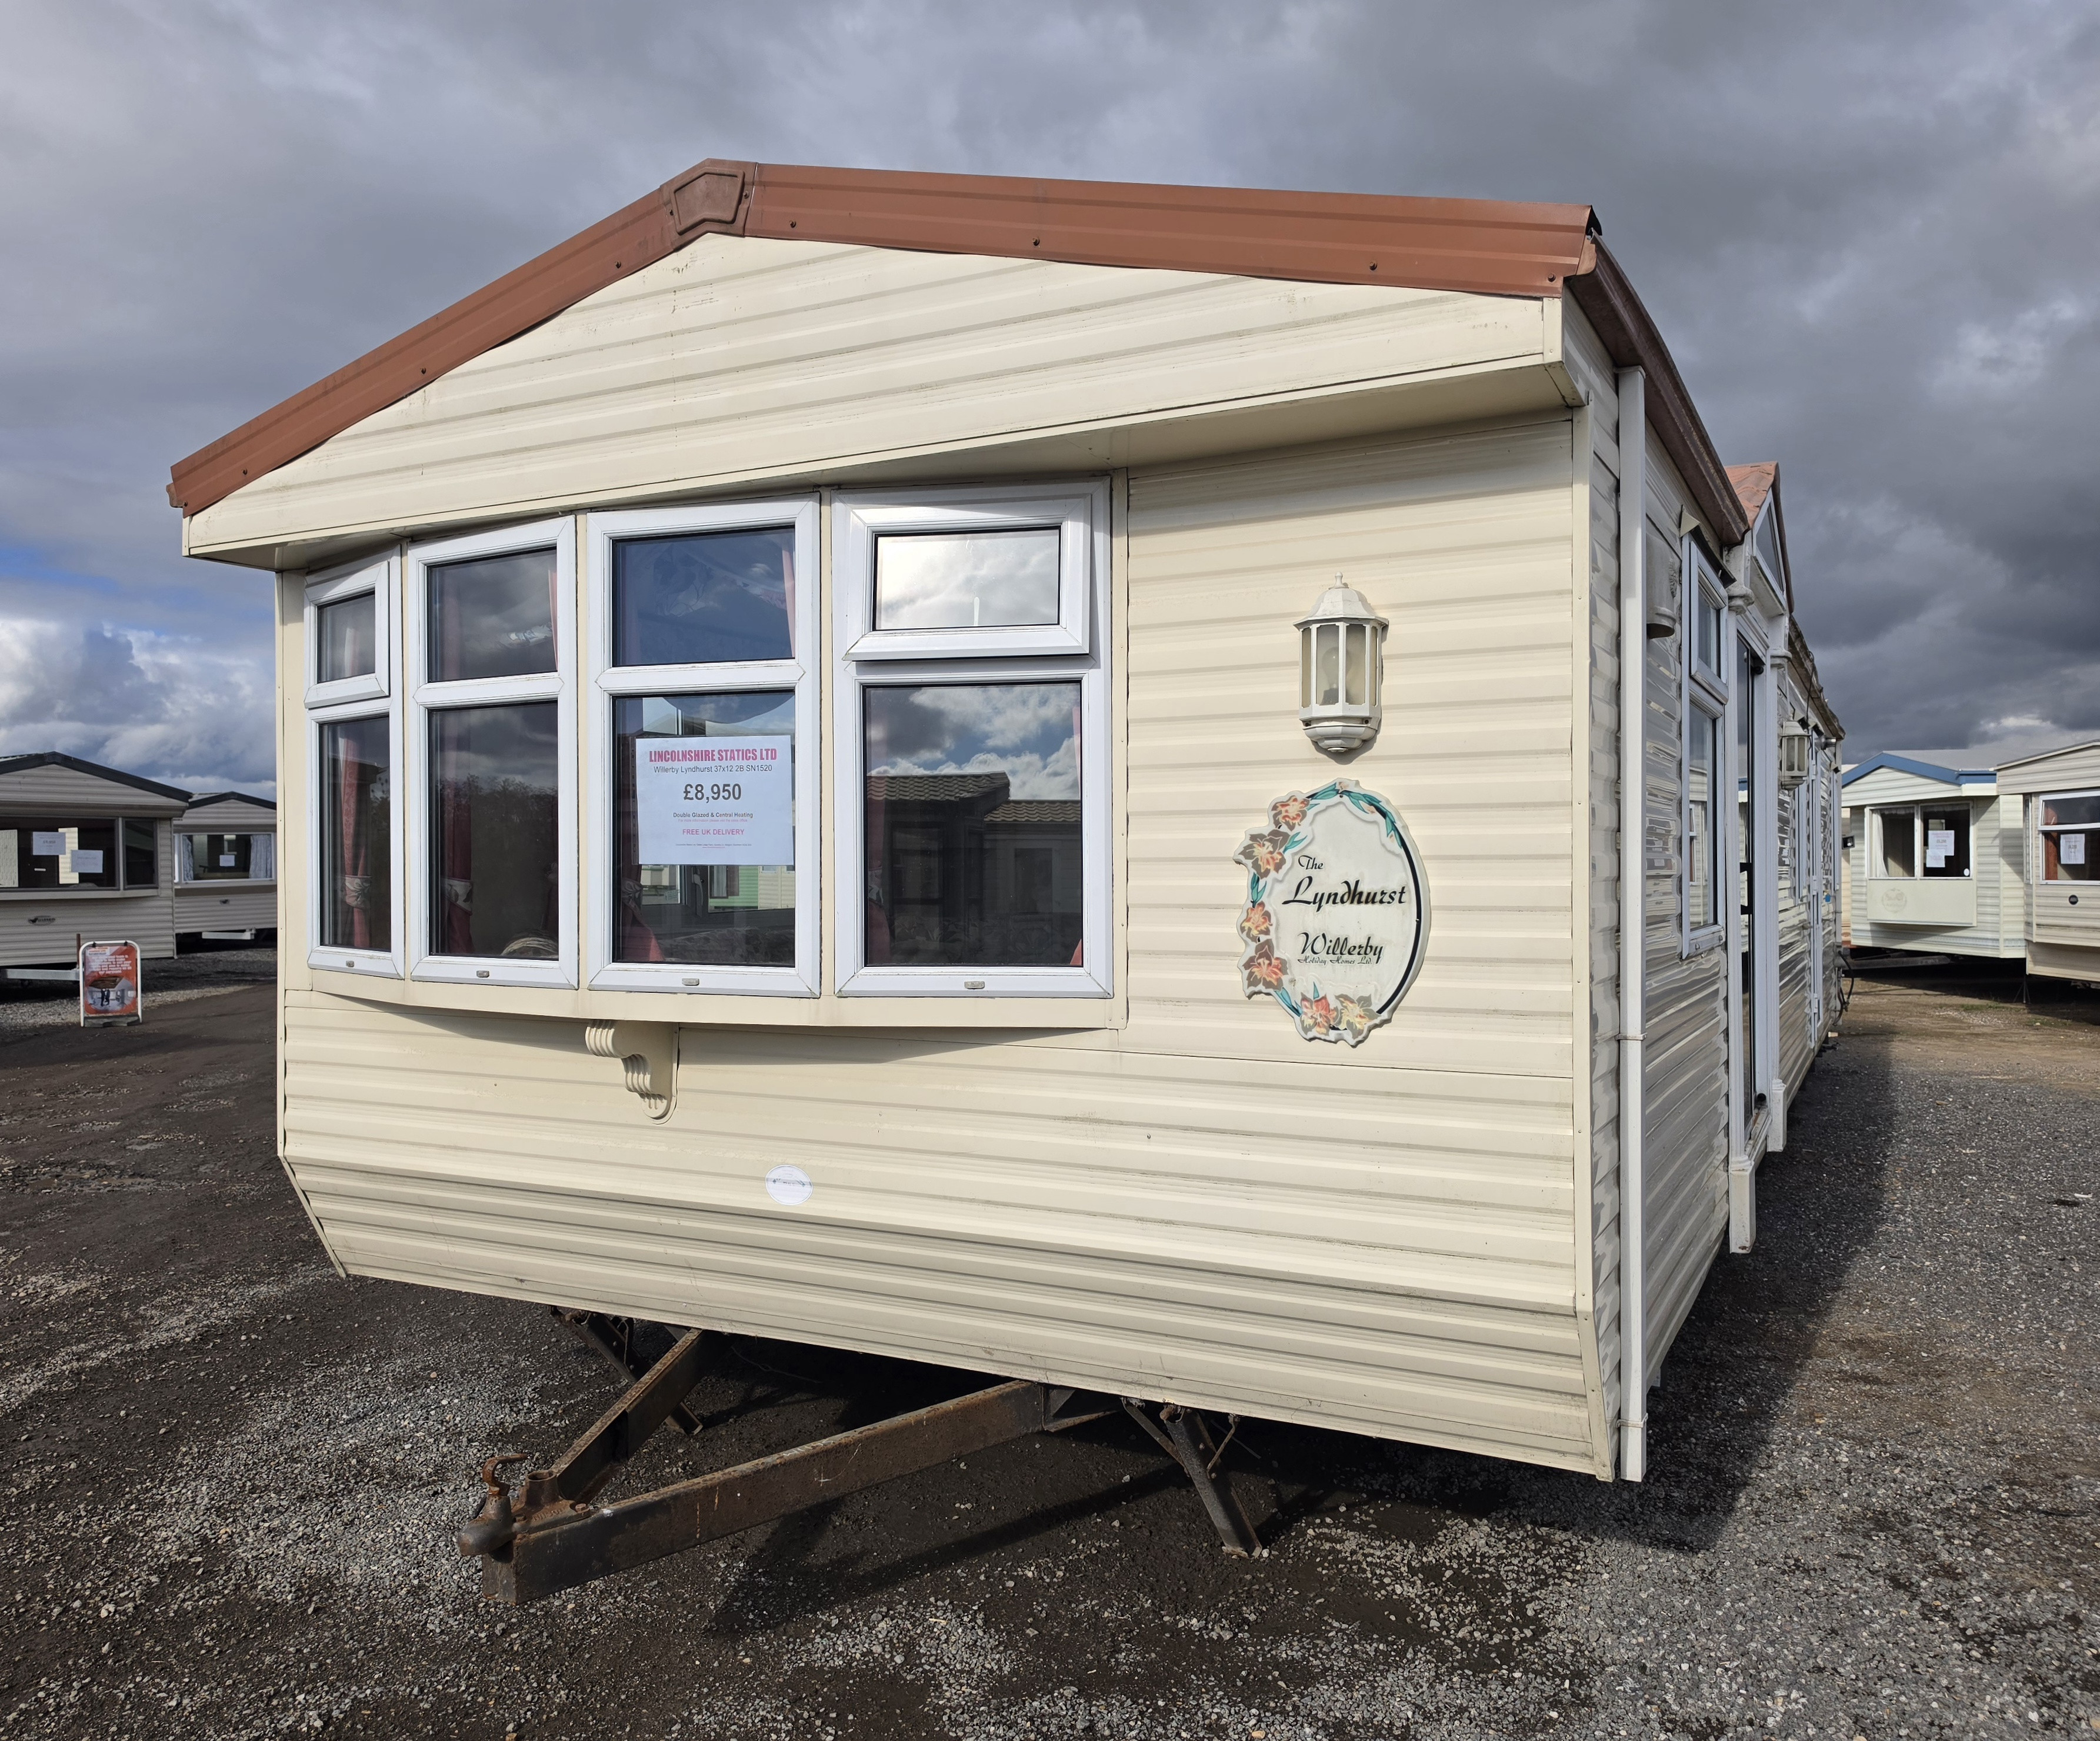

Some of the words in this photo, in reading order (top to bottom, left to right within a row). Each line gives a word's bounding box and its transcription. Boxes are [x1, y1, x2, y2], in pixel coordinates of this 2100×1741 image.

[649, 749, 716, 763] LINCOLNSHIRE
[717, 749, 758, 762] STATICS
[759, 748, 777, 761] LTD
[654, 766, 679, 774] Willerby
[681, 765, 712, 774] Lyndhurst
[683, 783, 742, 804] £8,950
[1298, 855, 1324, 870] The
[1281, 876, 1407, 912] Lyndhurst
[1297, 932, 1384, 964] Willerby
[1297, 955, 1327, 965] Holiday
[1329, 956, 1355, 964] Homes
